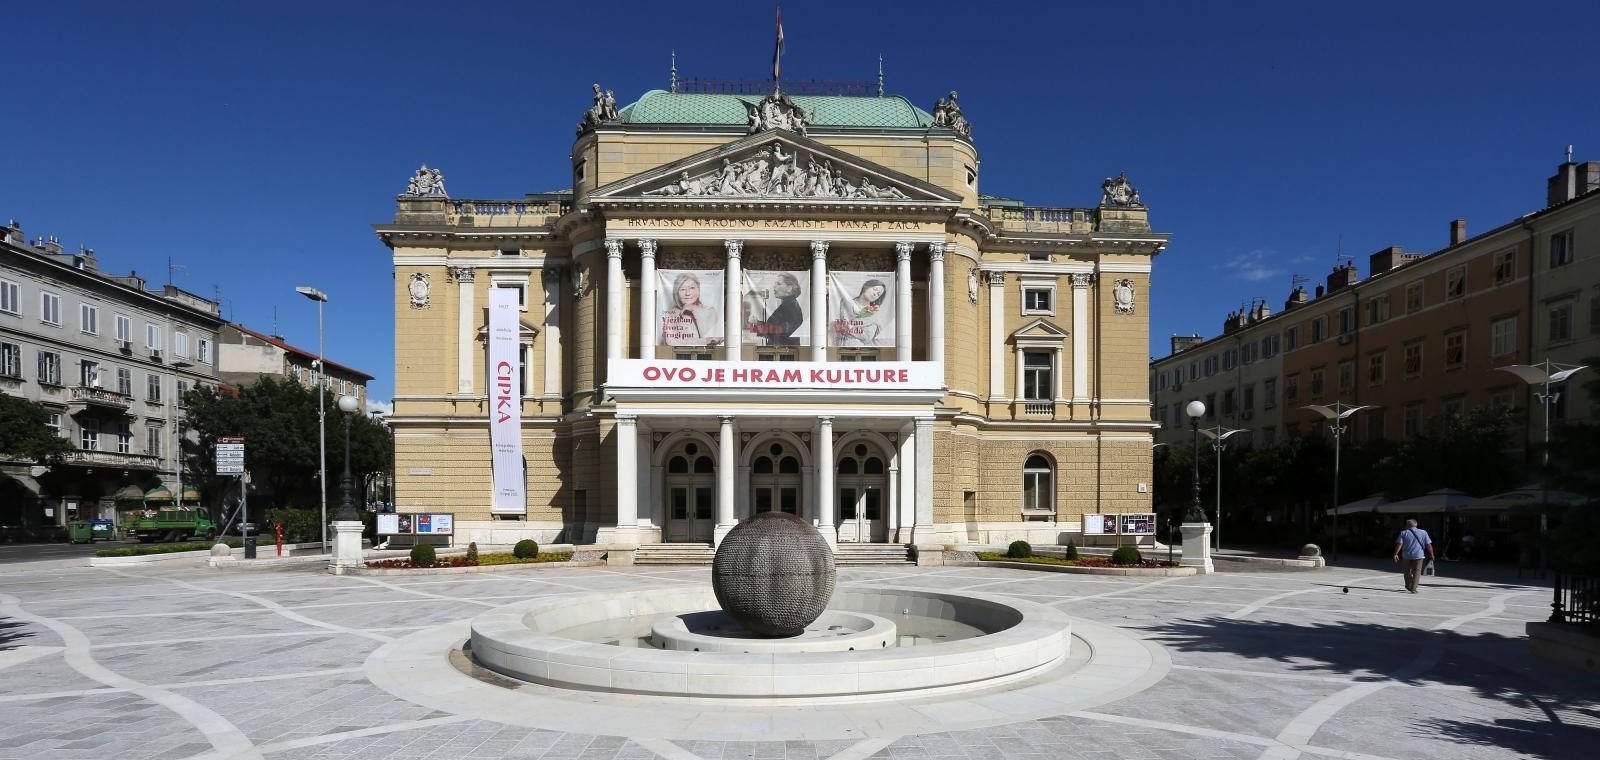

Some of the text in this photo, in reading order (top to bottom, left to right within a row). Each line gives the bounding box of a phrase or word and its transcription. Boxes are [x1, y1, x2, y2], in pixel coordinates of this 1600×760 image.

[628, 218, 685, 227] HRVATSKO
[694, 219, 756, 228] NARODNO
[836, 220, 869, 229] IVANA
[642, 366, 909, 384] OVO JE HRAM KULTURE
[497, 360, 514, 424] ČIPKA
